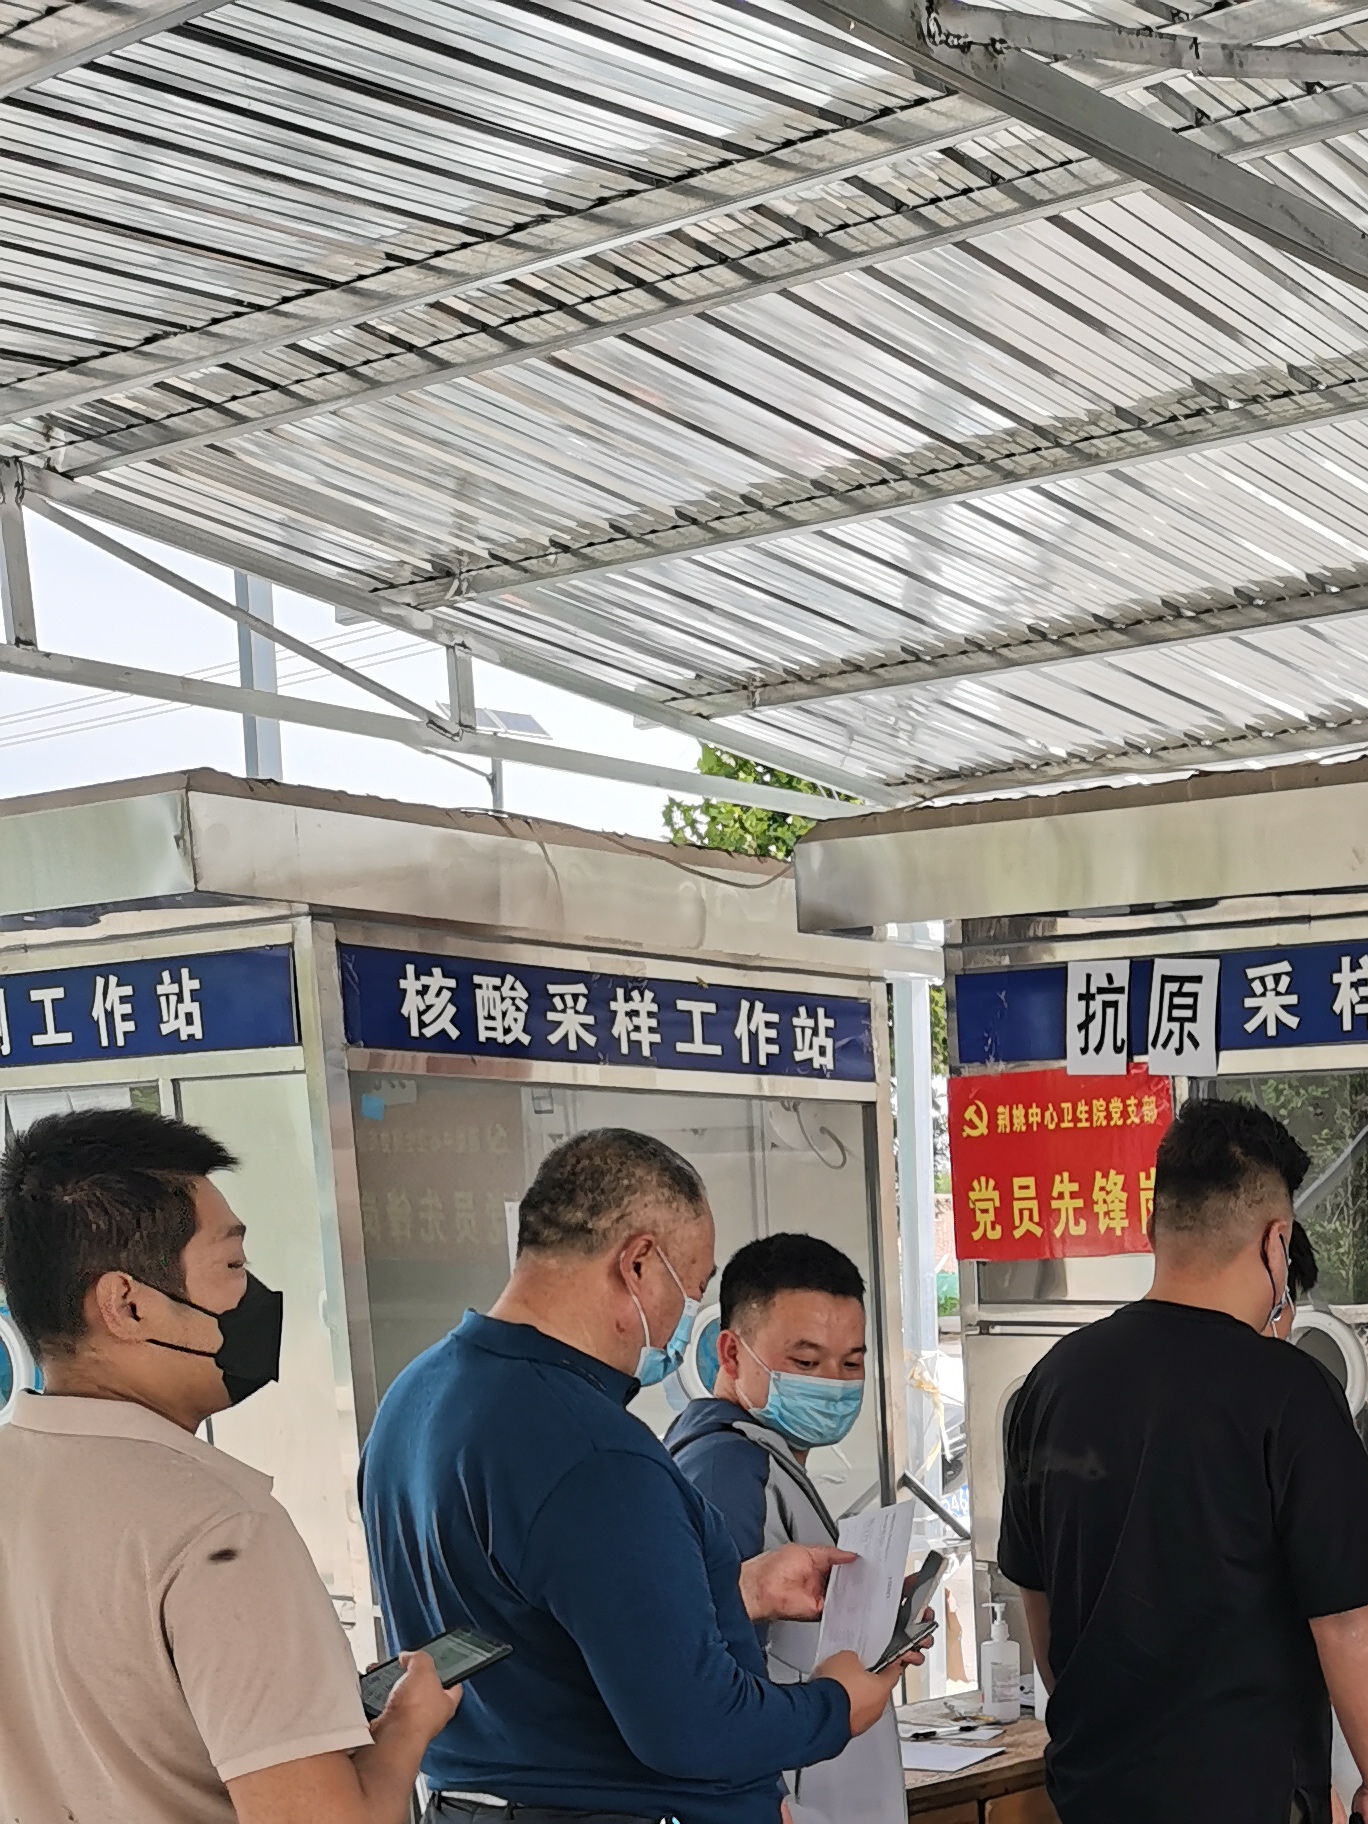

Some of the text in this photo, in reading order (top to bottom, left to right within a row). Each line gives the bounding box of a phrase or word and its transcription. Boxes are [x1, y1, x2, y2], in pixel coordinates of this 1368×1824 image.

[0, 967, 204, 1056] 工作站
[400, 963, 836, 1071] 核酸采样工作站
